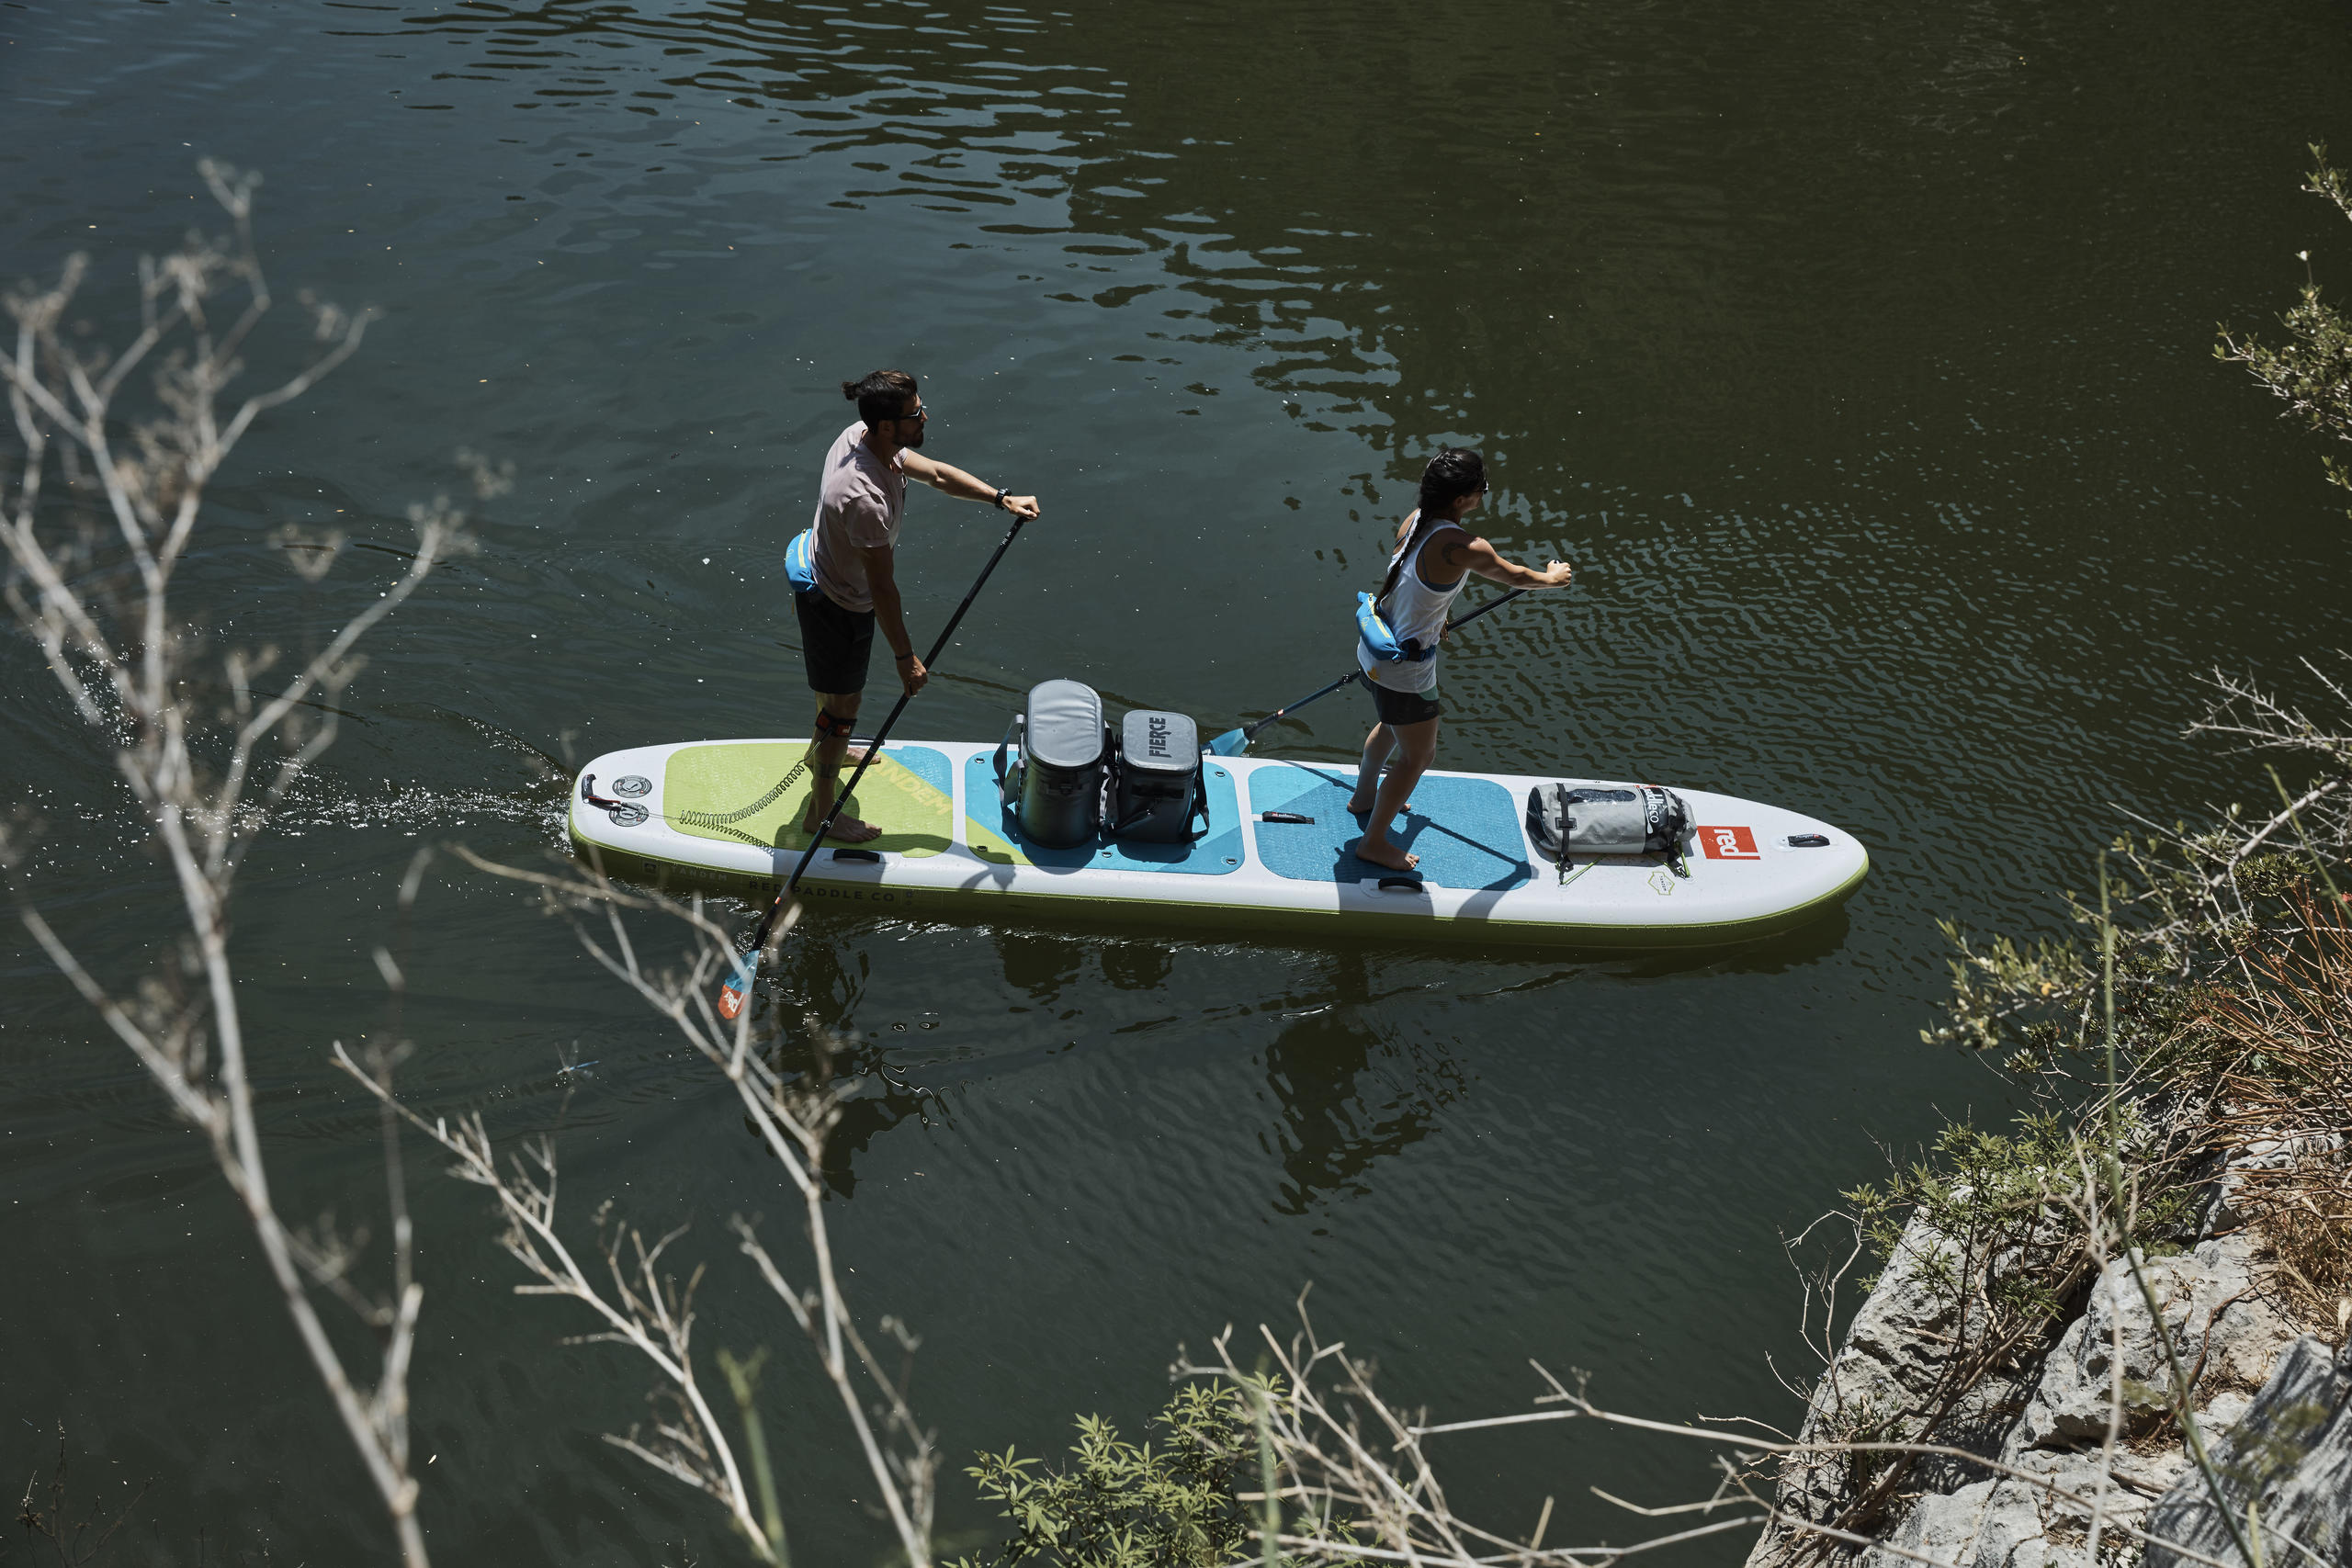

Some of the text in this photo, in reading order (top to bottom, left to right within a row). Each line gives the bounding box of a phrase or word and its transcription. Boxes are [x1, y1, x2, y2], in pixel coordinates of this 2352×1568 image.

[1149, 717, 1172, 758] FIERCE
[874, 758, 953, 816] ANDEM
[1713, 829, 1760, 857] red
[670, 865, 729, 883] TANDEM
[749, 880, 895, 902] RED PADDLE CO
